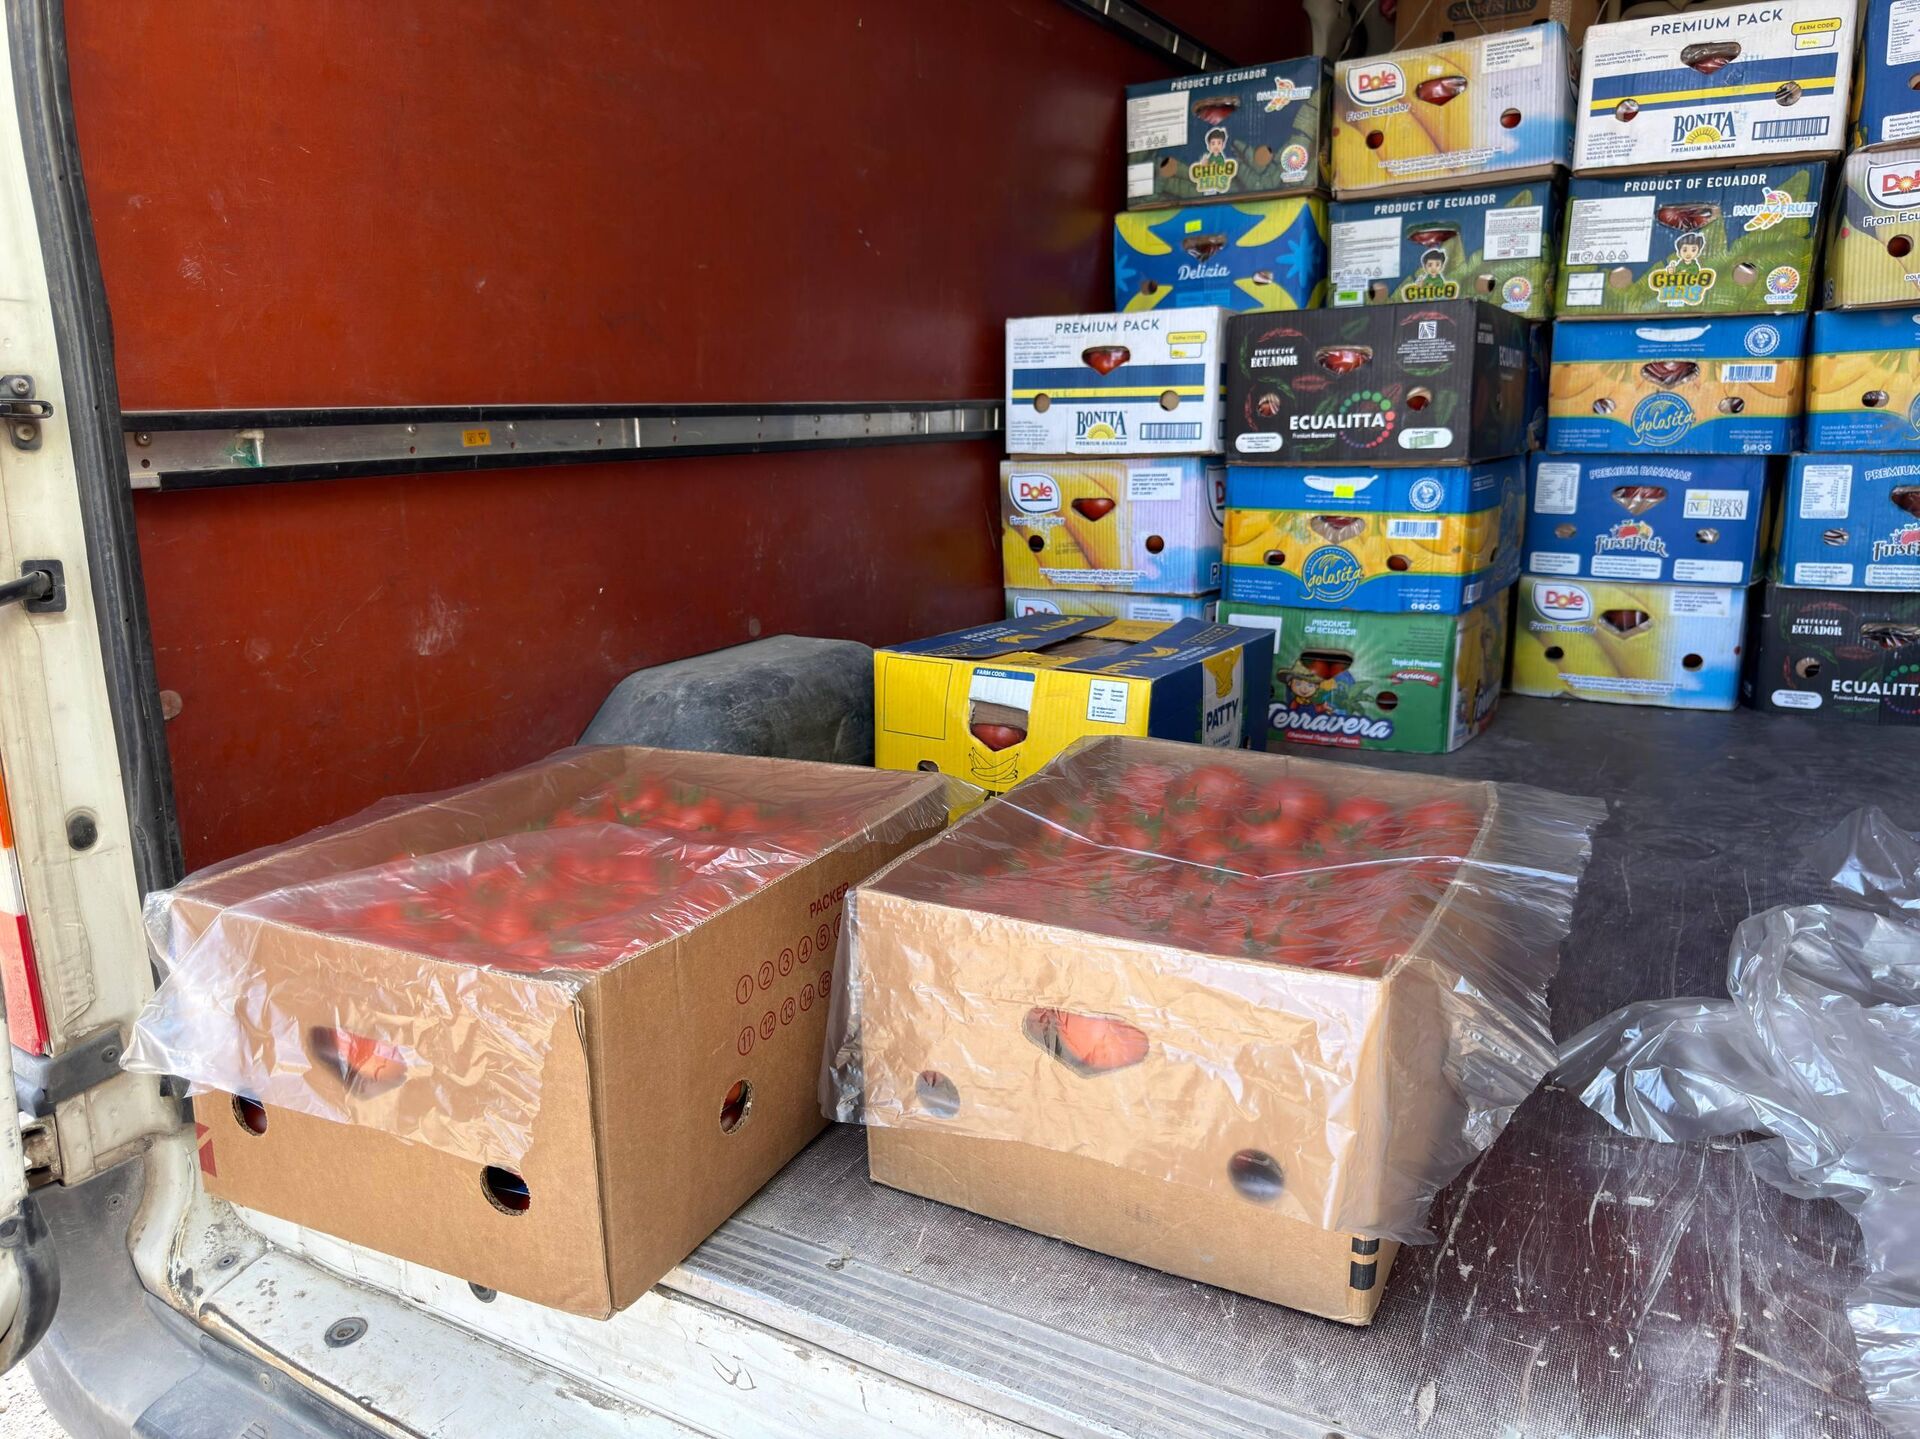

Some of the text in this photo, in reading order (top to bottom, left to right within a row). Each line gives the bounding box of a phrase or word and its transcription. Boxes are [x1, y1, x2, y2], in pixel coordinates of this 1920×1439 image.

[1650, 8, 1783, 37] PREMIUM PACK
[1170, 68, 1267, 91] PRODUCT OF ECUADOR
[1358, 71, 1397, 91] Dole
[1346, 103, 1410, 122] From Ecuador
[1671, 111, 1737, 143] BONITA
[1191, 161, 1236, 179] CHICO
[1624, 174, 1767, 192] PRODUCT OF ECUADOR
[1374, 194, 1497, 215] PRODUCT OF ECUADOR
[1863, 216, 1895, 228] From
[1177, 263, 1231, 281] Delizia
[1652, 271, 1713, 288] CHICO
[1404, 284, 1458, 301] CHICO
[1054, 319, 1161, 334] PREMIUM PACK
[1250, 355, 1298, 369] ECUADOR
[1076, 410, 1127, 436] BONITA
[1289, 413, 1385, 431] ECUALITTA
[1589, 465, 1692, 481] PREMIUM BANANAS
[1020, 482, 1052, 498] Dole
[1712, 506, 1743, 517] BAN
[1545, 590, 1584, 608] Dole
[1304, 626, 1357, 636] OF ECUADOR
[1311, 619, 1352, 628] PRODUCT
[1530, 621, 1595, 633] From Ecuador
[1791, 624, 1842, 636] ECUADOR
[976, 668, 1007, 678] FARM CODE:
[1831, 679, 1920, 697] ECUALITT
[1206, 697, 1240, 733] PATTY
